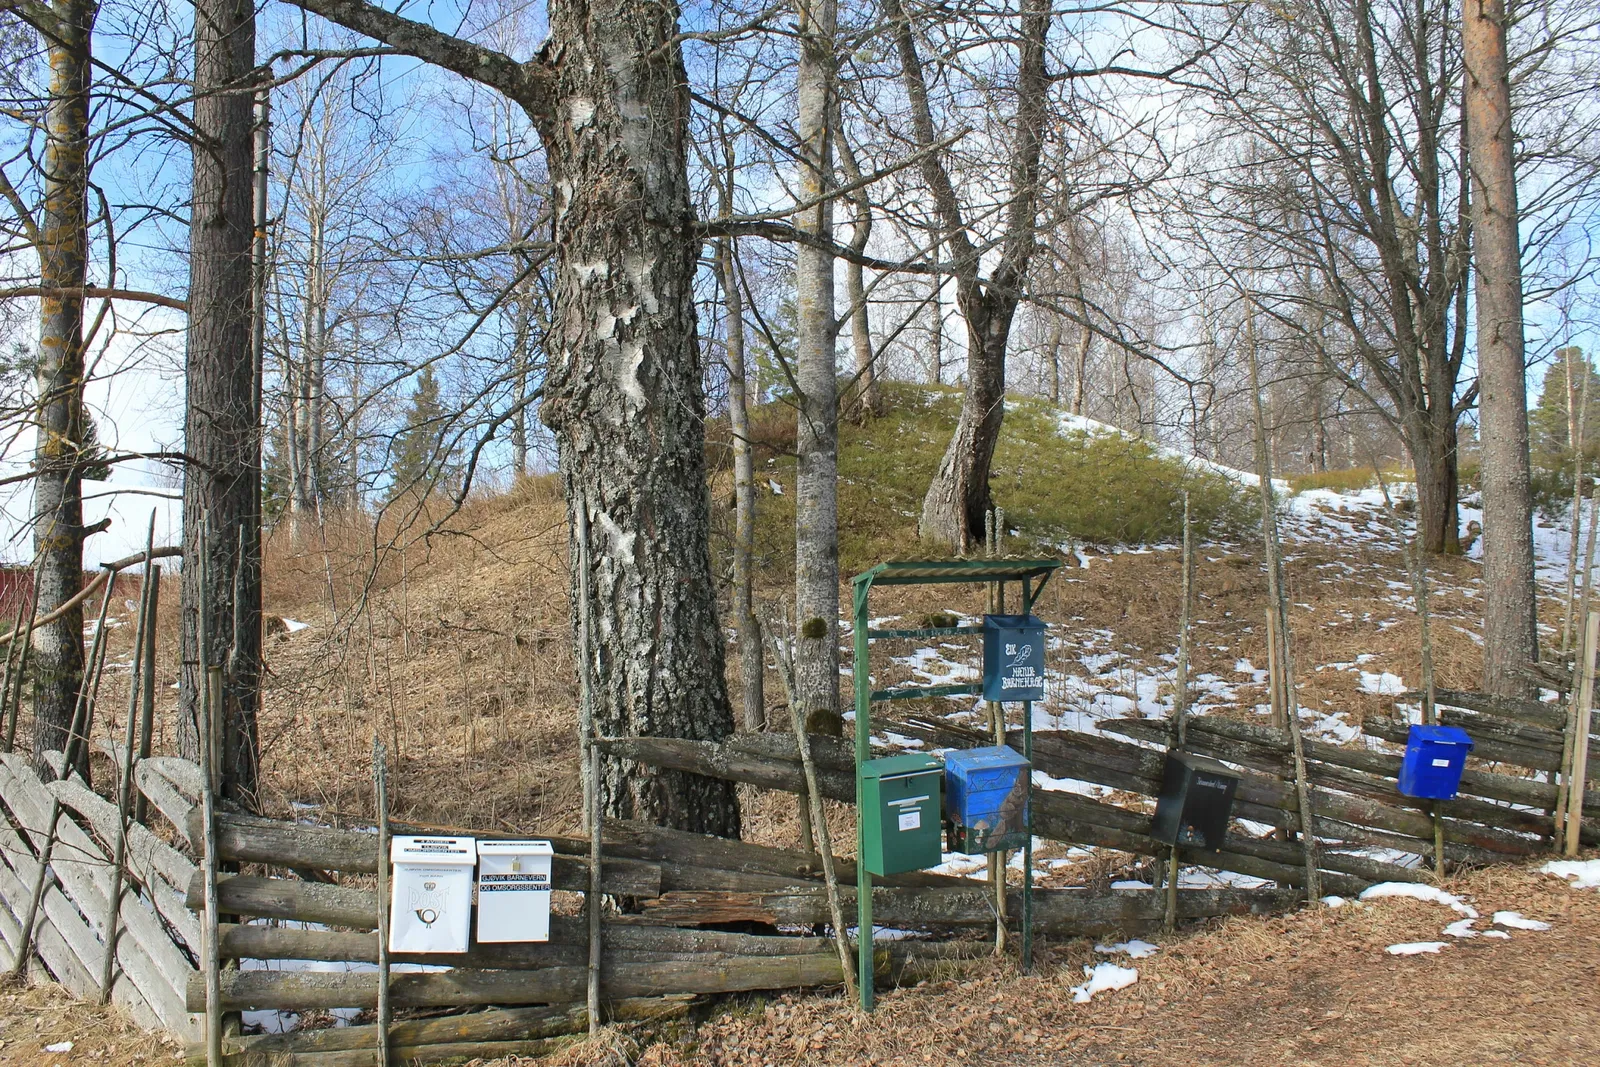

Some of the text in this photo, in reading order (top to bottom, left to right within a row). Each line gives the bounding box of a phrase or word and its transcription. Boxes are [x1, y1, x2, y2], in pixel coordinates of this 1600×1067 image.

[1005, 643, 1017, 656] EIK
[482, 873, 546, 882] GJØVIK BARNEVERN
[407, 886, 450, 914] POST
